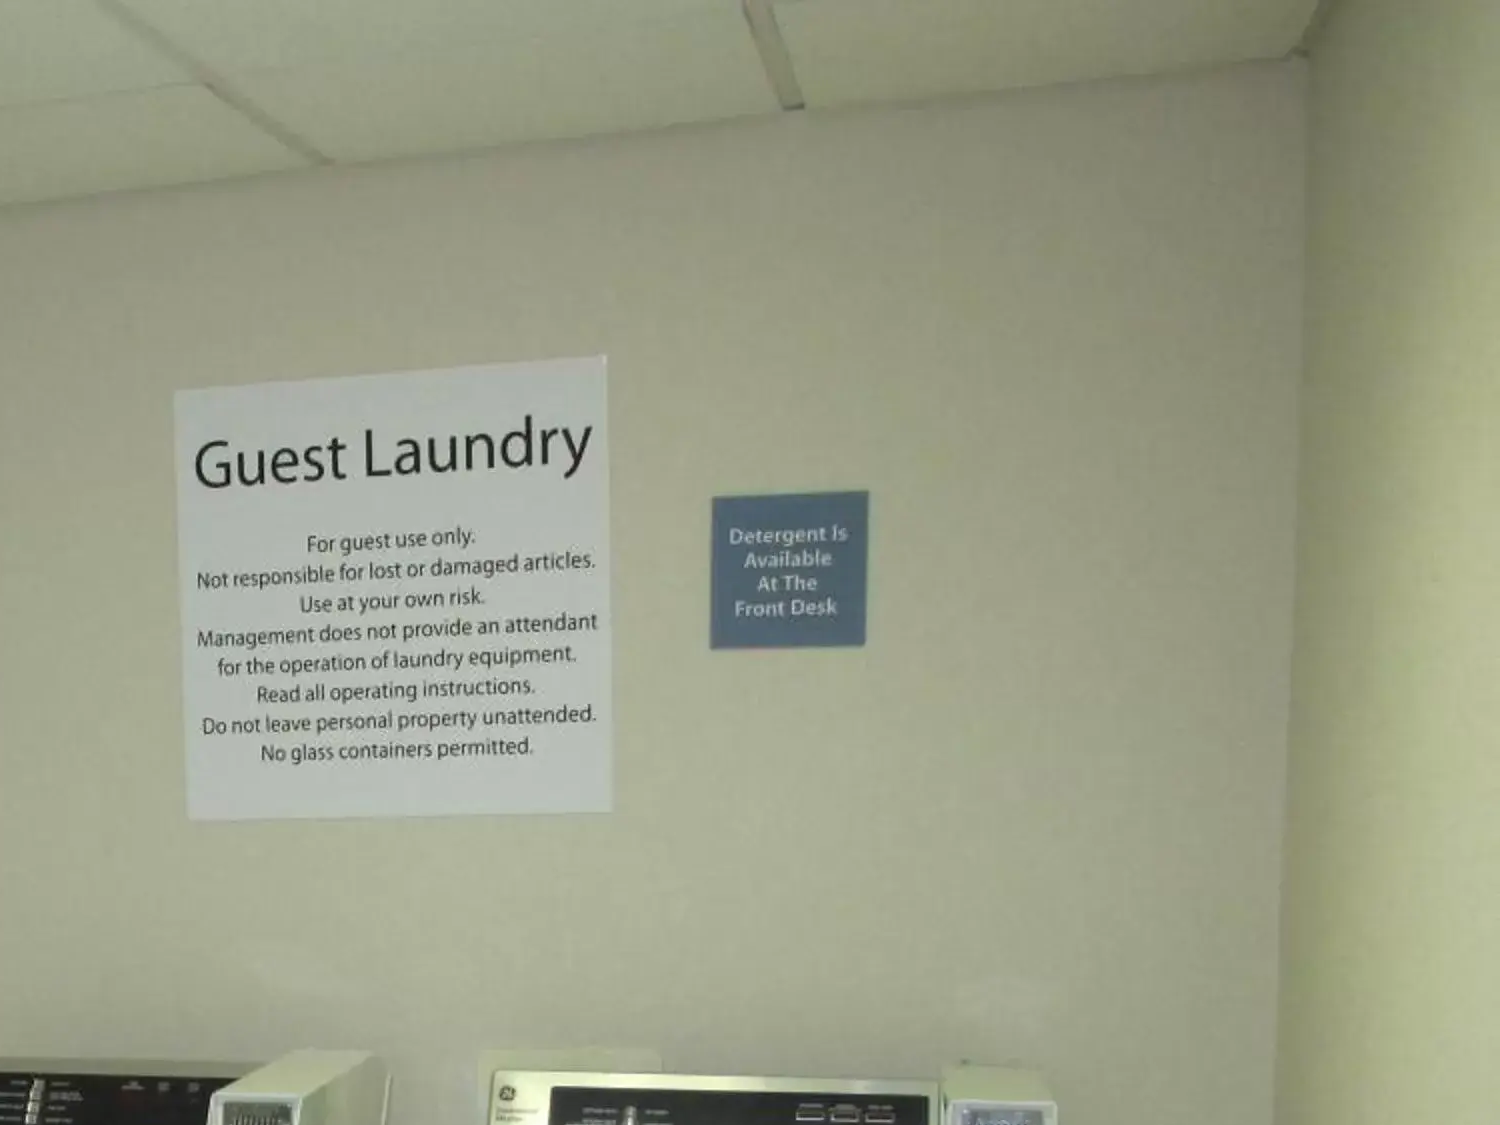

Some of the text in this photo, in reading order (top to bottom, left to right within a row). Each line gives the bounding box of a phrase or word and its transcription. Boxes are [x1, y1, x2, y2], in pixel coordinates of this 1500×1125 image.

[195, 415, 593, 489] Guest Laundry
[307, 526, 476, 555] For guest use only.
[729, 524, 848, 546] Detergent Is
[197, 551, 596, 590] Not responsible for lost or damaged articles.
[743, 549, 832, 568] Available
[757, 575, 818, 592] At The
[300, 587, 485, 615] Use at your own risk.
[734, 597, 837, 617] Front Desk
[197, 613, 598, 650] Management does not provide an attendant
[218, 646, 576, 677] for the operation of laundry equipment.
[257, 676, 535, 704] Read all operating instructions.
[202, 705, 597, 735] Do not leave personal property unattended.
[261, 738, 533, 764] No glass containers permitted.
